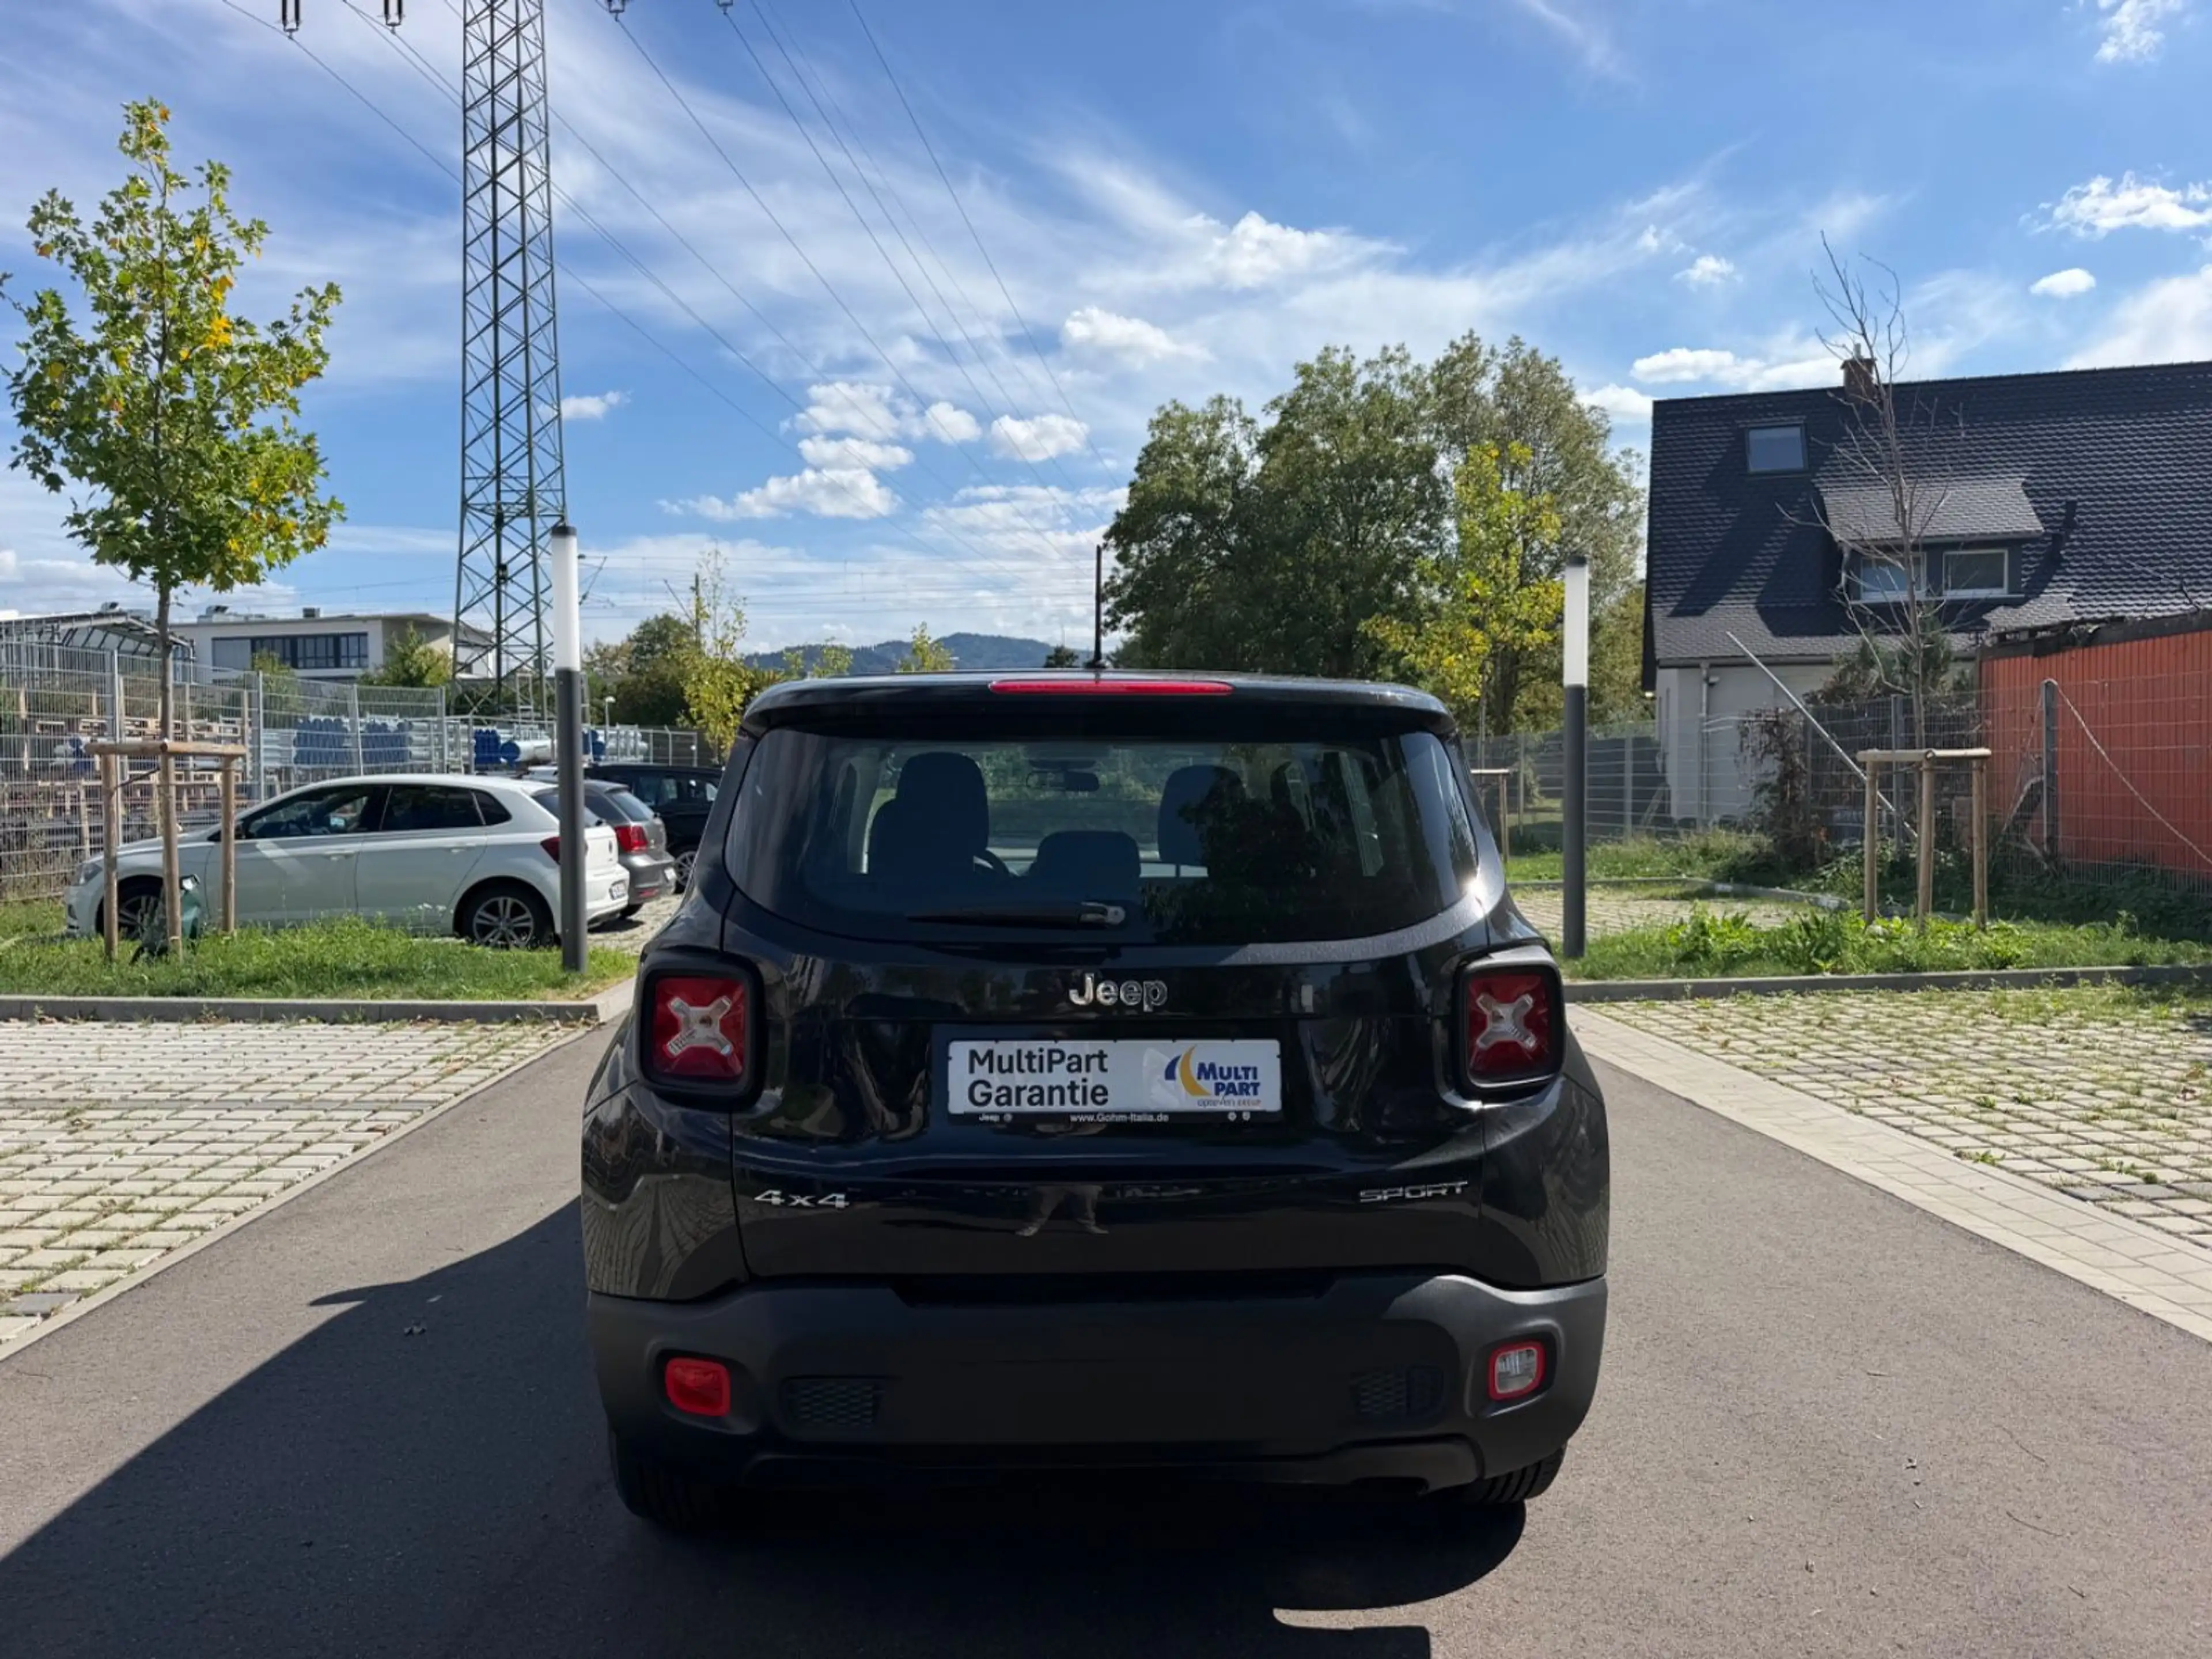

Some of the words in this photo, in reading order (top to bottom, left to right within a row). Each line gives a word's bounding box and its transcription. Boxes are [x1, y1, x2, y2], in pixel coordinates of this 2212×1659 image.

[1069, 972, 1168, 1012] Jeep
[968, 1048, 1108, 1074] MultiPart
[1196, 1062, 1257, 1080] MULTI
[968, 1078, 1108, 1107] Garantie
[1214, 1082, 1260, 1096] PART
[753, 1190, 850, 1209] 4x4
[1359, 1180, 1468, 1203] SPORT
